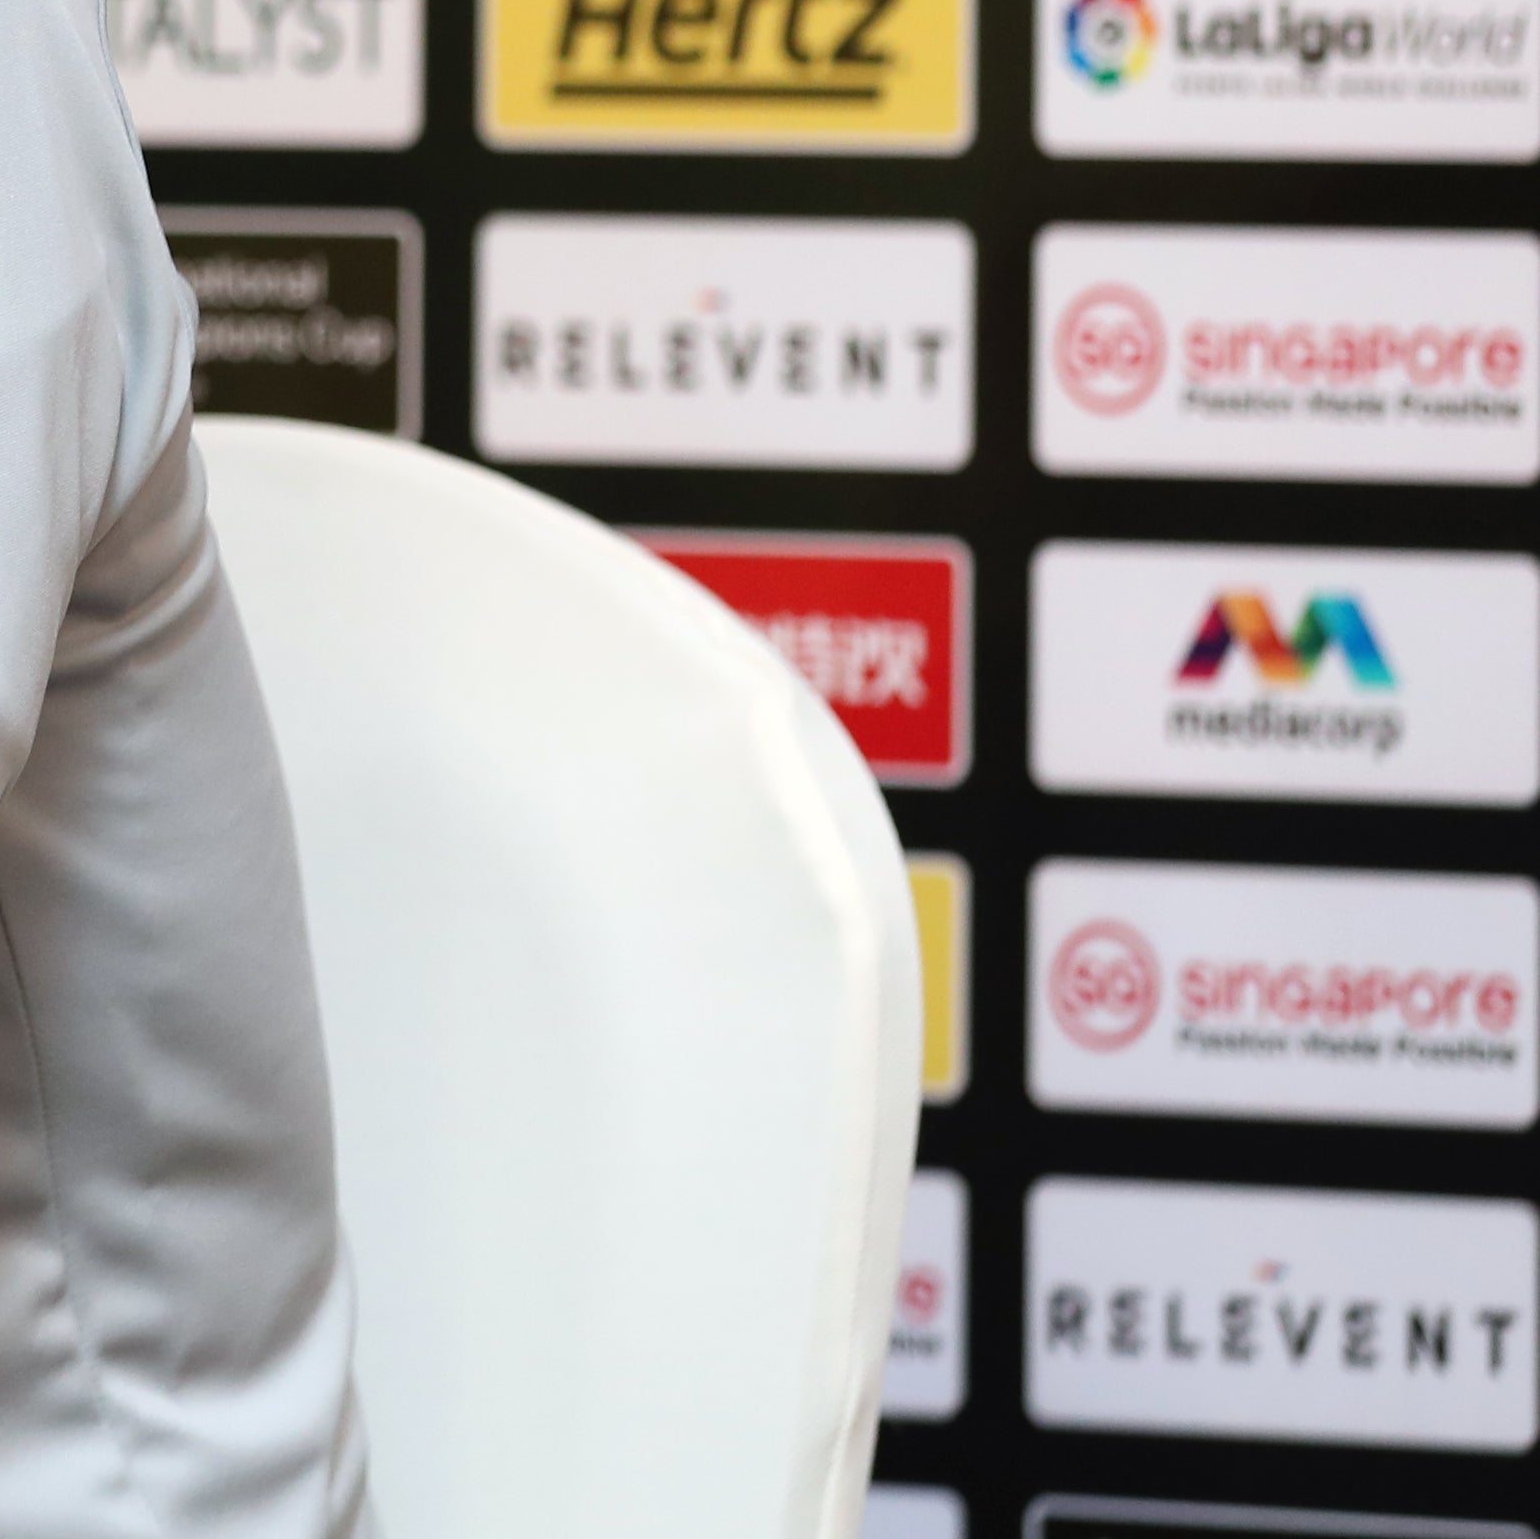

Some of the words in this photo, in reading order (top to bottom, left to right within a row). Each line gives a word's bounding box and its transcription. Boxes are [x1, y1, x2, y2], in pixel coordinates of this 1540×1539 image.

[499, 322, 951, 394] RELEVENT
[1169, 702, 1403, 760] mediacorp
[1049, 1284, 1519, 1376] RELEVENT
